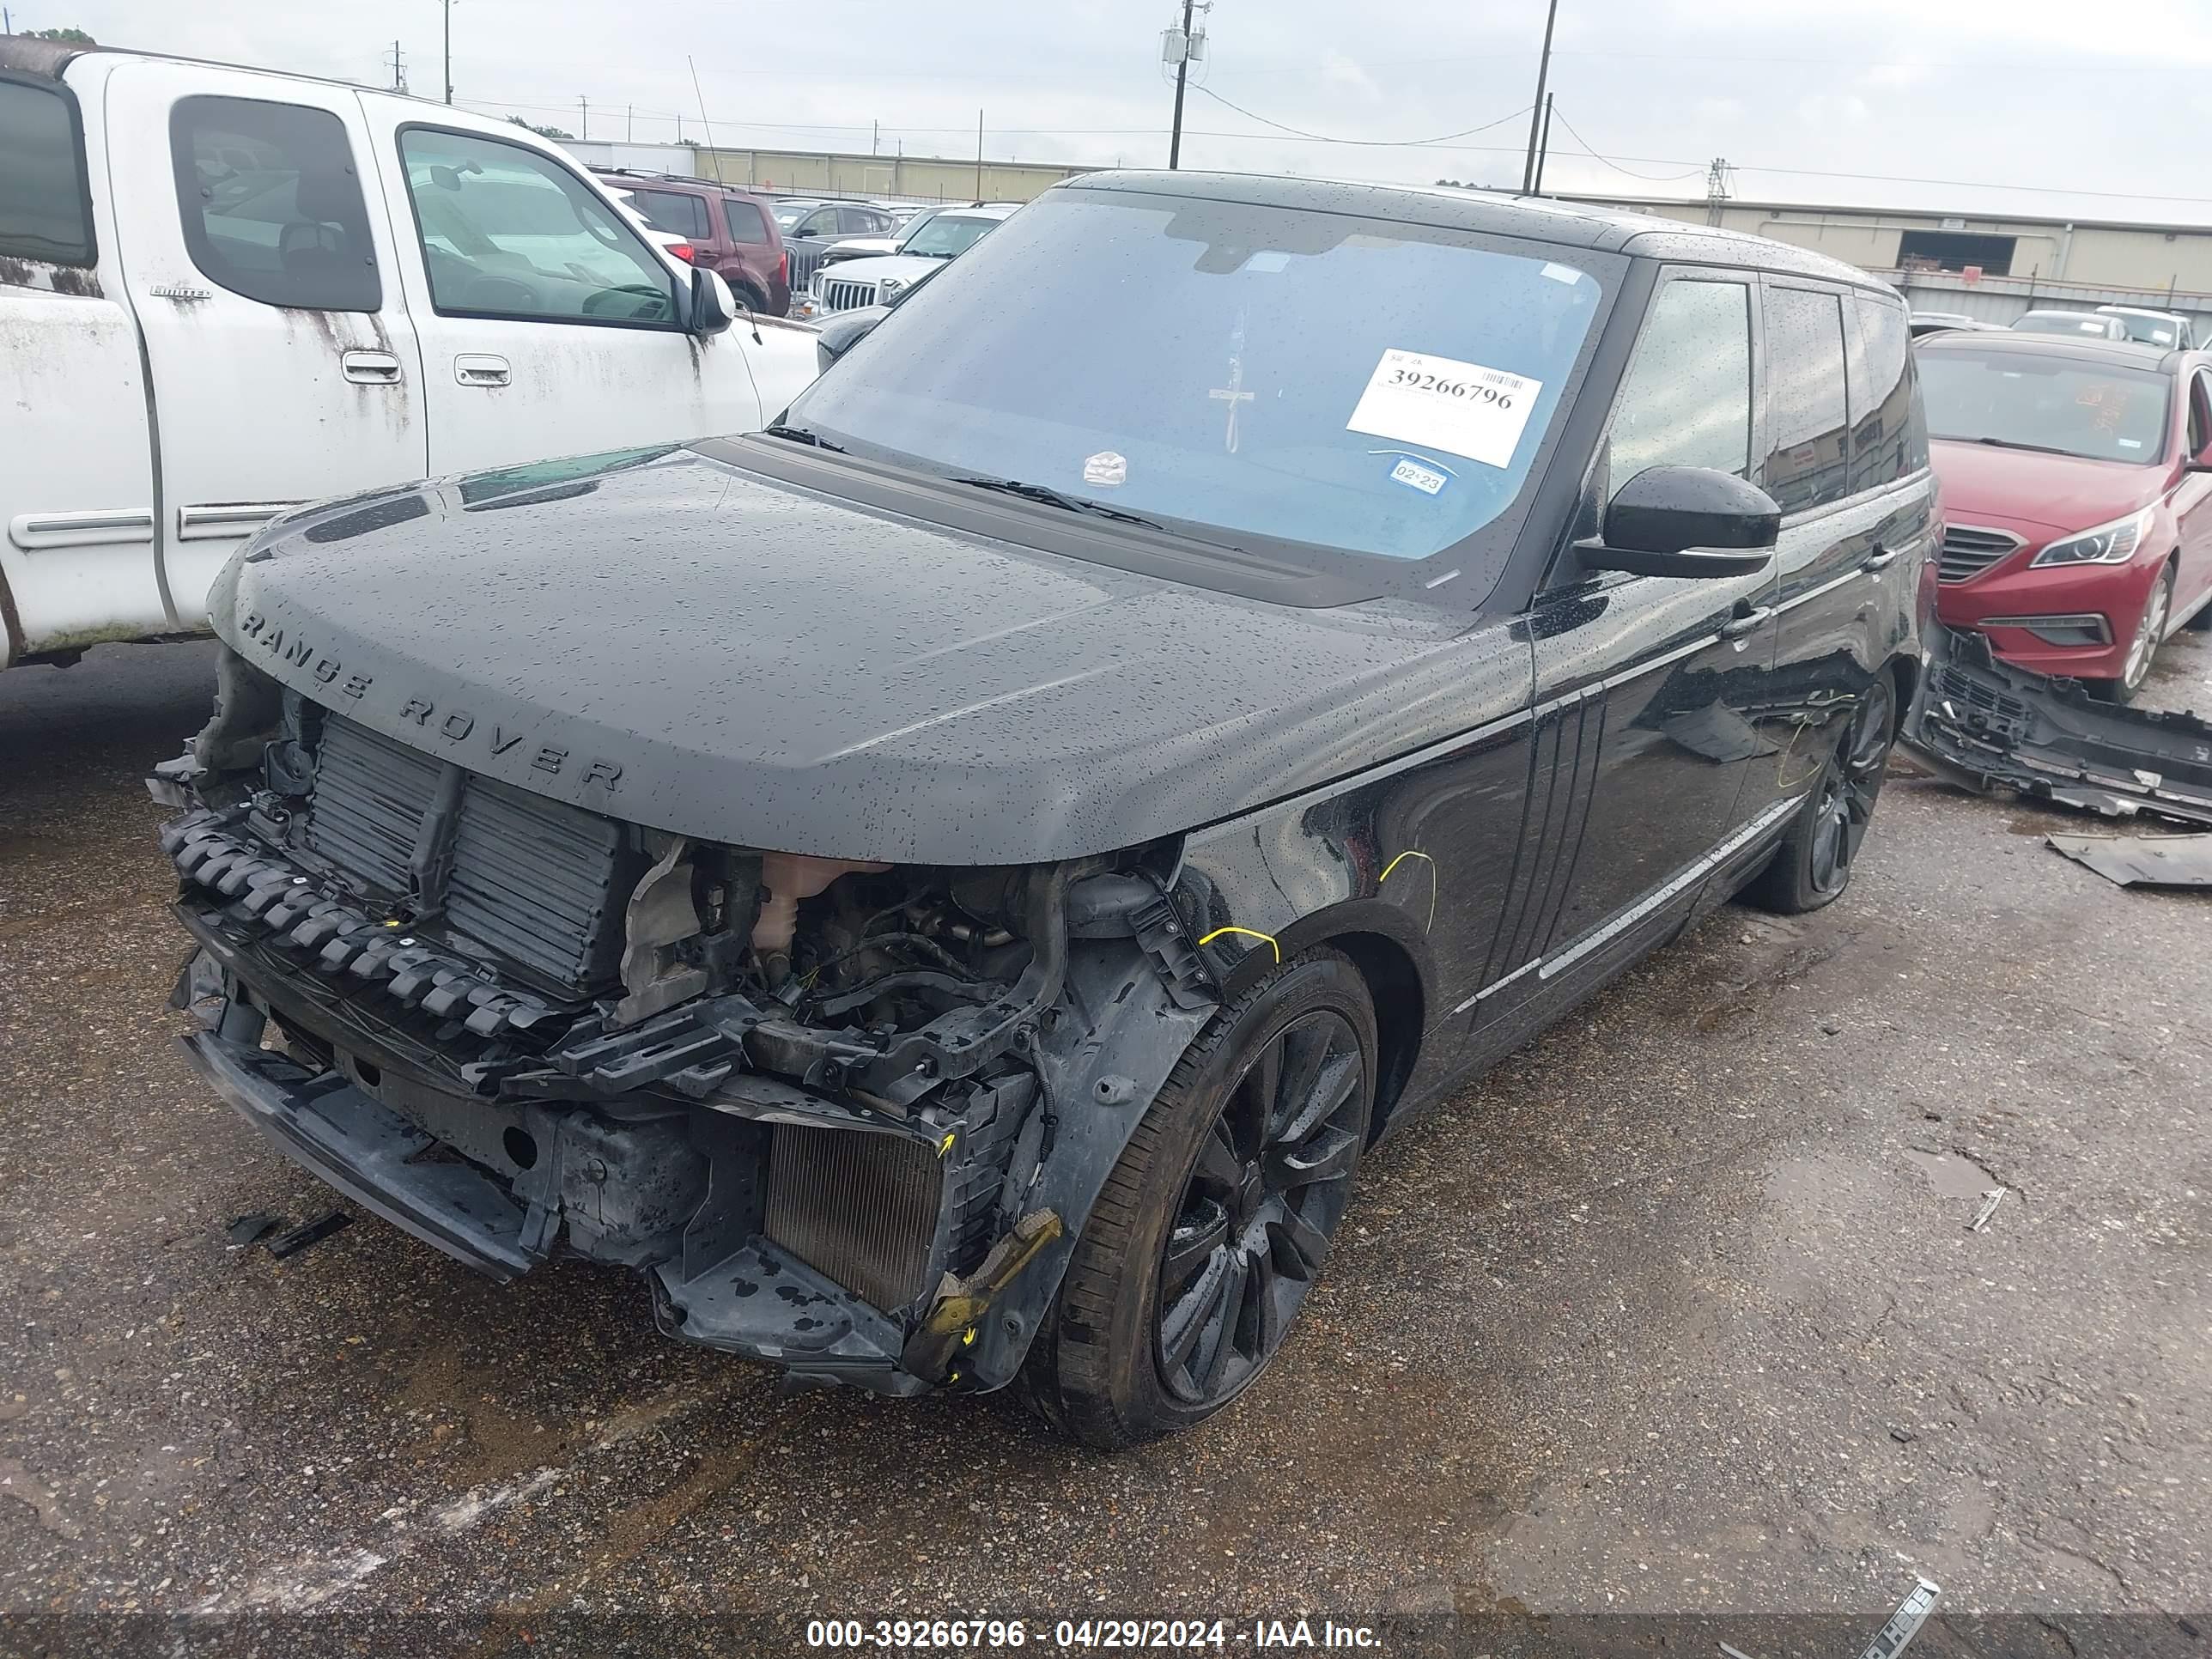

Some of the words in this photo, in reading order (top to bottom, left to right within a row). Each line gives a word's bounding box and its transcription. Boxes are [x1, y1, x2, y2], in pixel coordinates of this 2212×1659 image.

[149, 285, 213, 299] LIMITED
[1389, 369, 1514, 410] 39266796
[241, 614, 373, 699] RANGE
[399, 699, 623, 792] ROVER
